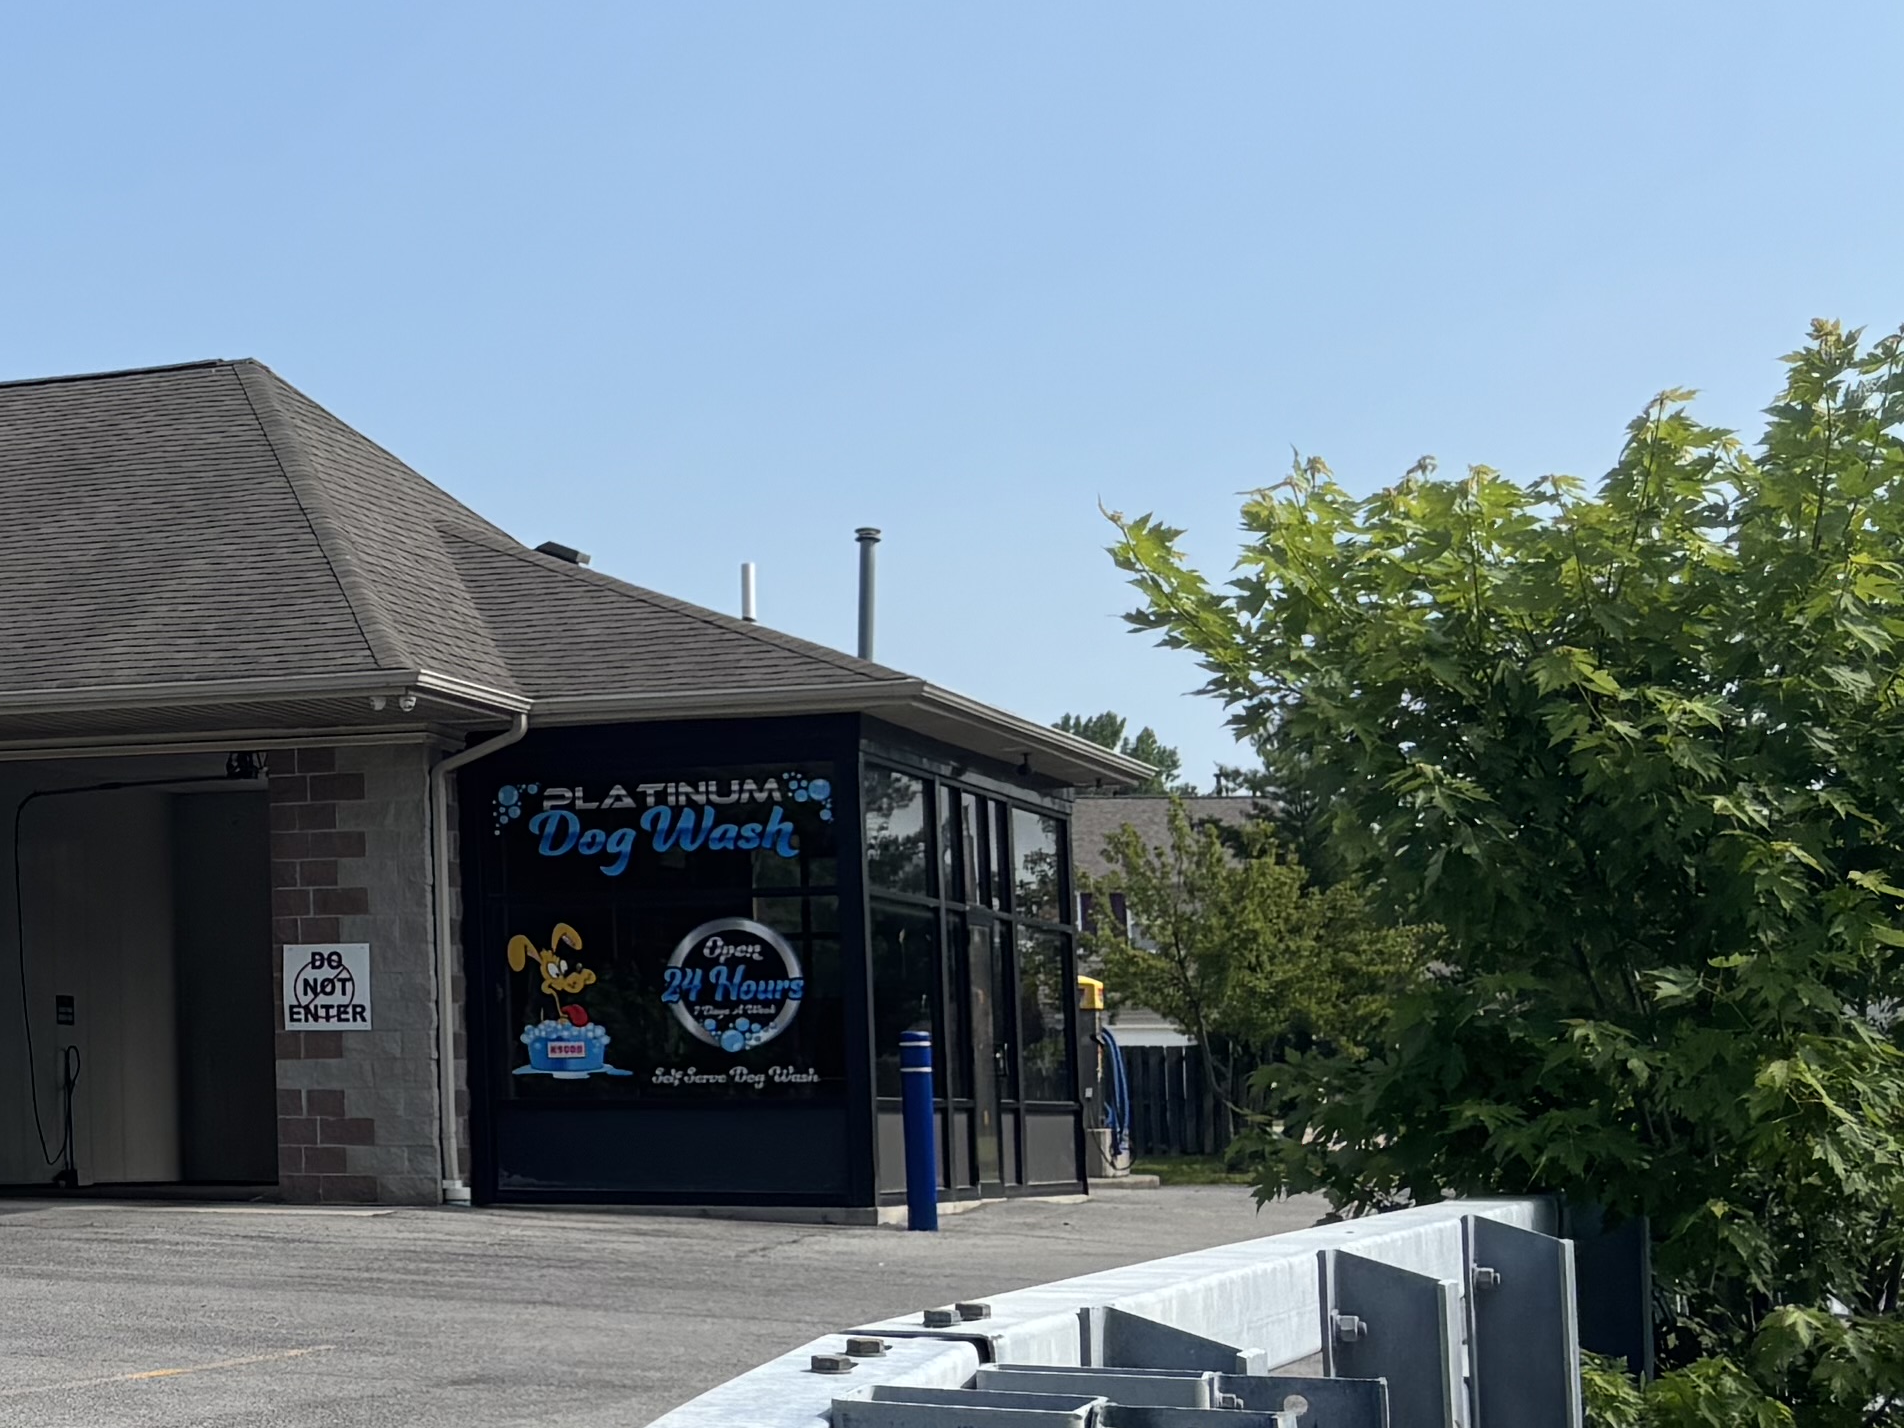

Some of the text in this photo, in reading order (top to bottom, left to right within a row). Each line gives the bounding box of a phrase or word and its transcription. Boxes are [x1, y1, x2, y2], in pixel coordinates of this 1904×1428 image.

[542, 777, 783, 812] PLATINUM
[528, 804, 801, 877] Dog Wash
[310, 950, 343, 970] DO
[702, 935, 765, 964] Open
[302, 977, 352, 997] NOT
[660, 963, 805, 1003] 24 Hours
[288, 1003, 368, 1023] ENTER
[651, 1066, 684, 1088] Self
[728, 1065, 766, 1090] Dog
[767, 1064, 821, 1084] Wash
